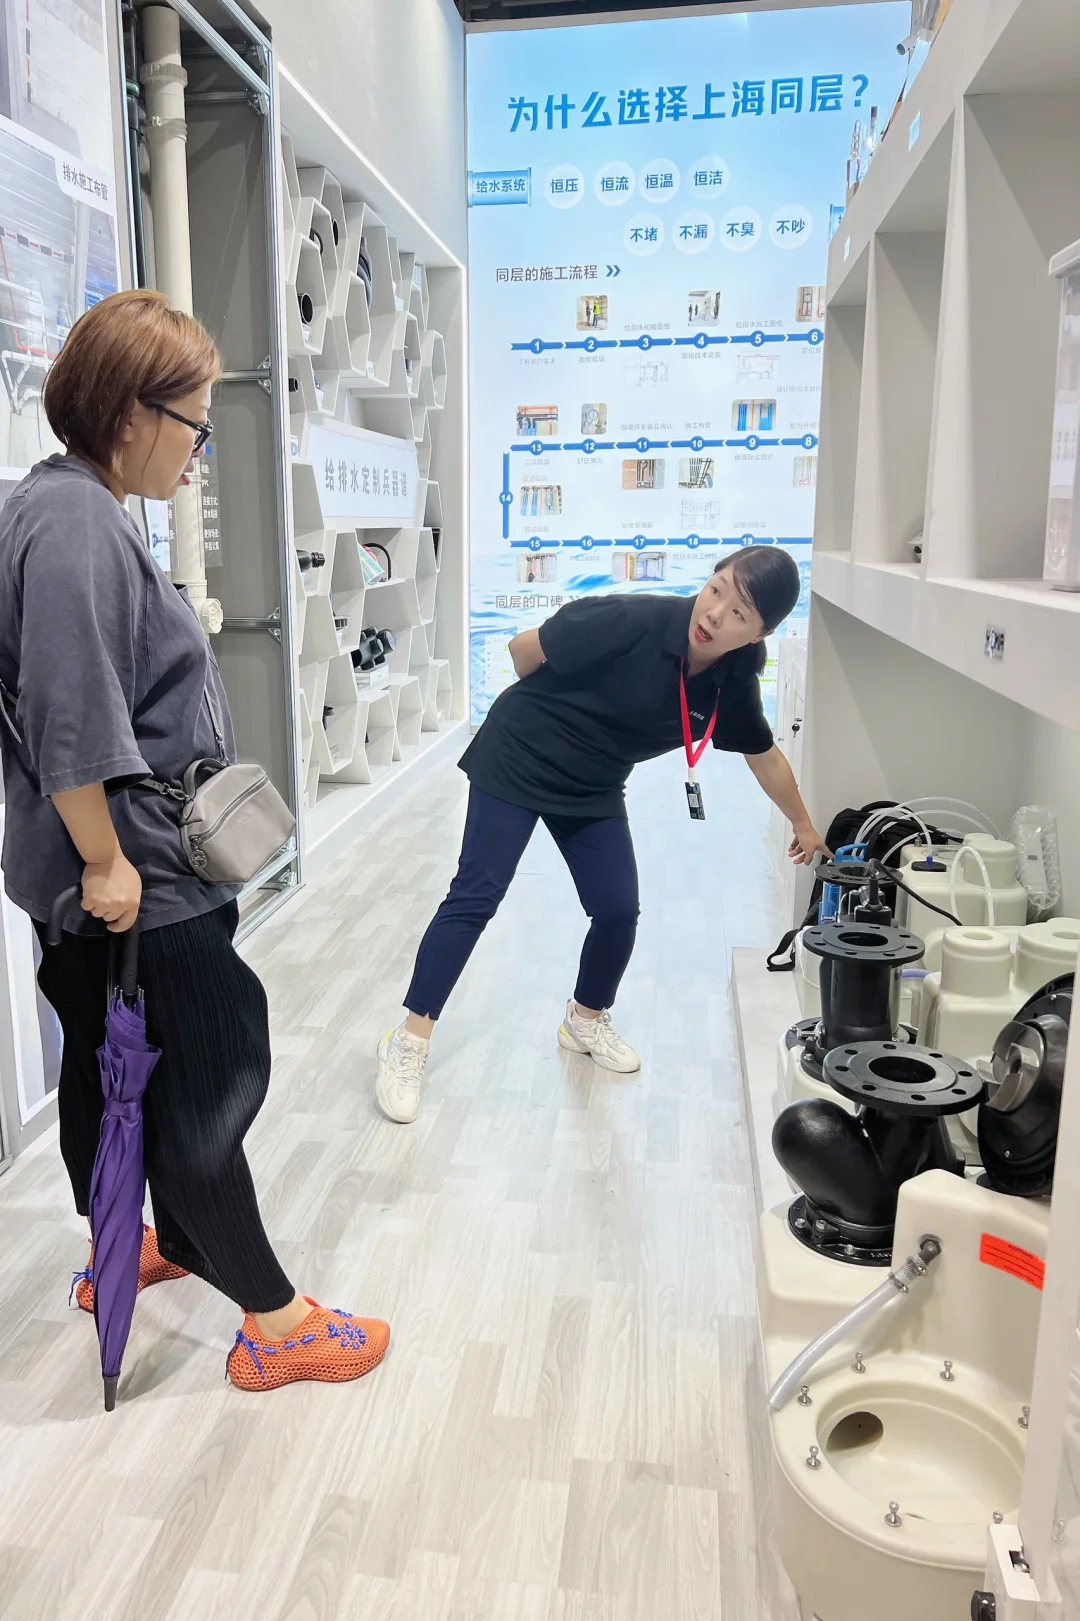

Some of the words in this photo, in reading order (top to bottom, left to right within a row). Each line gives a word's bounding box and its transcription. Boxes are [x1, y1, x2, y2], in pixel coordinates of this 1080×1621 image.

[507, 73, 871, 133] 为什么选择上海同层?
[62, 162, 108, 201] 排水施工布管
[645, 173, 674, 190] 恒温
[693, 169, 724, 187] 恒洁
[475, 178, 526, 194] 给水系统
[550, 178, 579, 194] 恒压
[600, 176, 630, 192] 恒流
[678, 223, 708, 240] 不漏
[725, 221, 755, 238] 不臭
[775, 219, 806, 235] 不吵
[629, 226, 659, 243] 不堵
[495, 264, 598, 282] 同层的施工流程
[697, 335, 705, 346] 4
[754, 334, 762, 344] 5
[811, 332, 819, 342] 6
[534, 341, 540, 351] 1
[587, 340, 595, 350] 2
[642, 338, 650, 348] 3
[584, 442, 595, 450] 12
[637, 441, 648, 449] 11
[692, 440, 703, 448] 10
[749, 437, 757, 447] 9
[805, 437, 812, 446] 8
[531, 444, 542, 452] 13
[530, 540, 541, 548] 15
[581, 539, 592, 547] 16
[634, 538, 645, 546] 17
[688, 537, 699, 545] 18
[743, 537, 753, 545] 19
[495, 595, 563, 608] 同层的口碑
